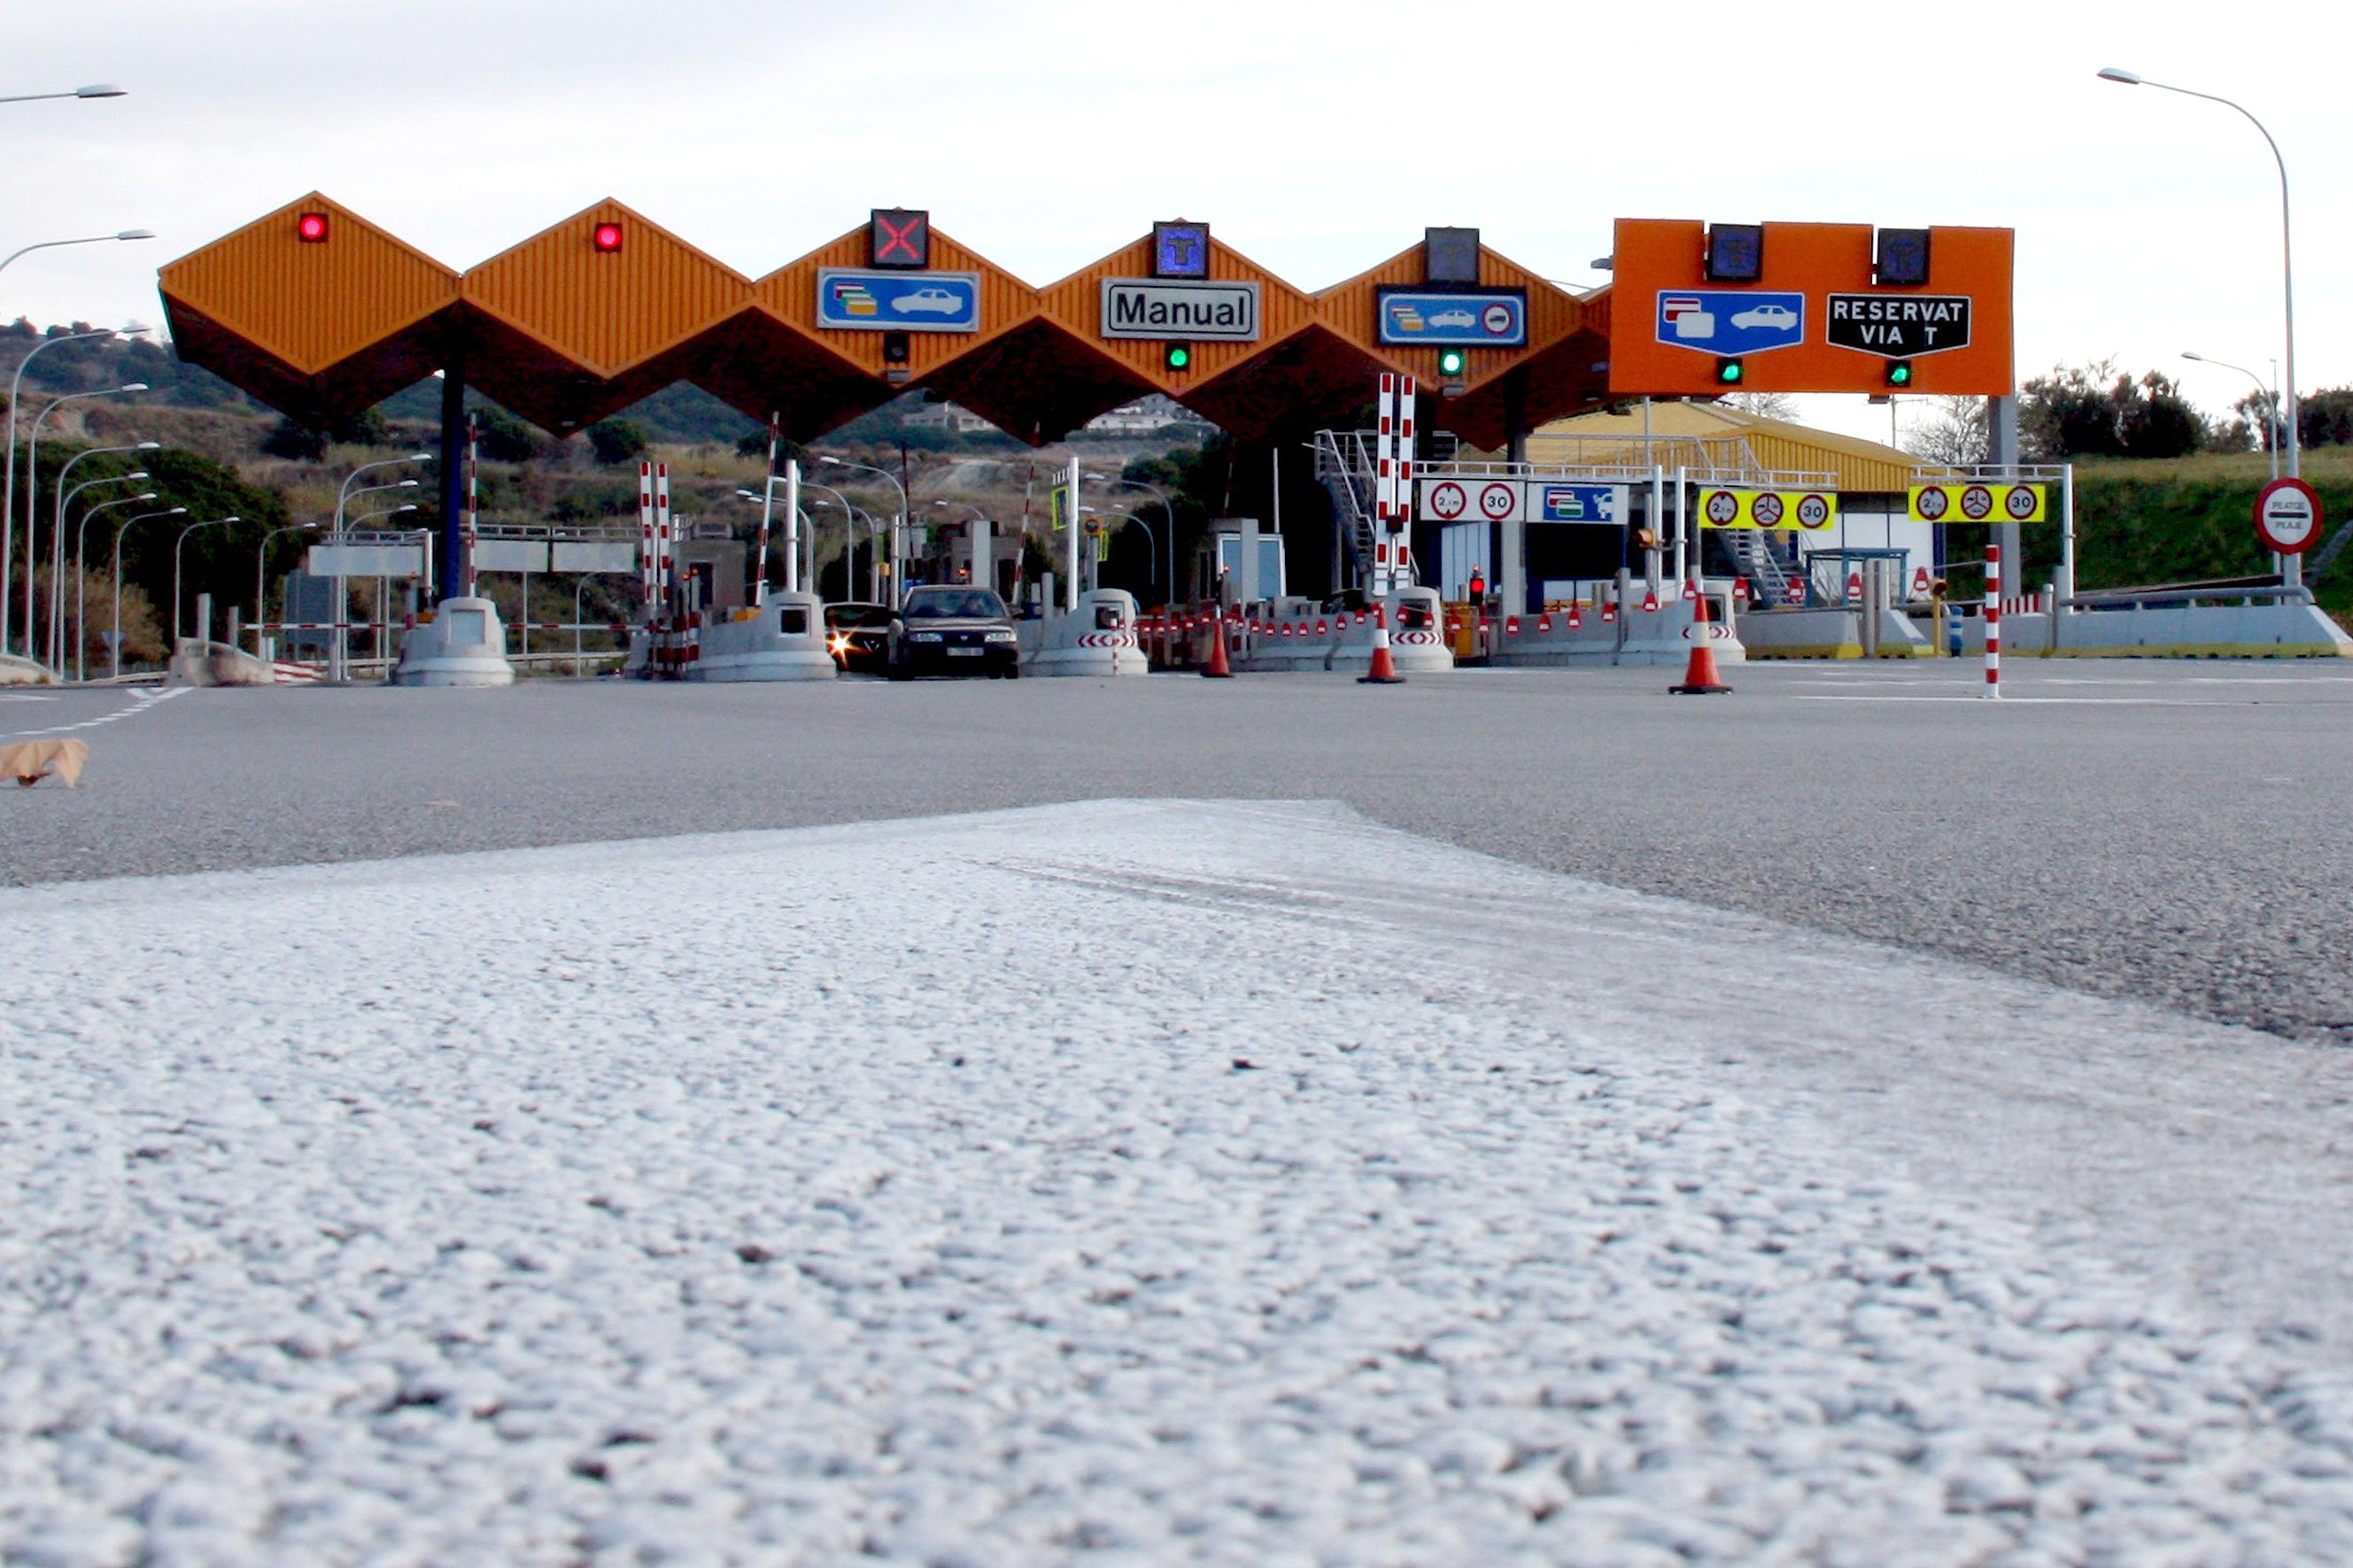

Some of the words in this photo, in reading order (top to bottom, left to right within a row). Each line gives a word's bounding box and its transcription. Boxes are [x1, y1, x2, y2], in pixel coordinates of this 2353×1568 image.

[1168, 237, 1196, 265] T
[1116, 293, 1244, 326] Manual
[1833, 300, 1963, 322] RESERVAT
[1860, 324, 1904, 345] VIA
[1924, 327, 1938, 345] T
[1487, 496, 1507, 508] 30
[1803, 506, 1823, 518] 30
[2012, 497, 2031, 508] 30
